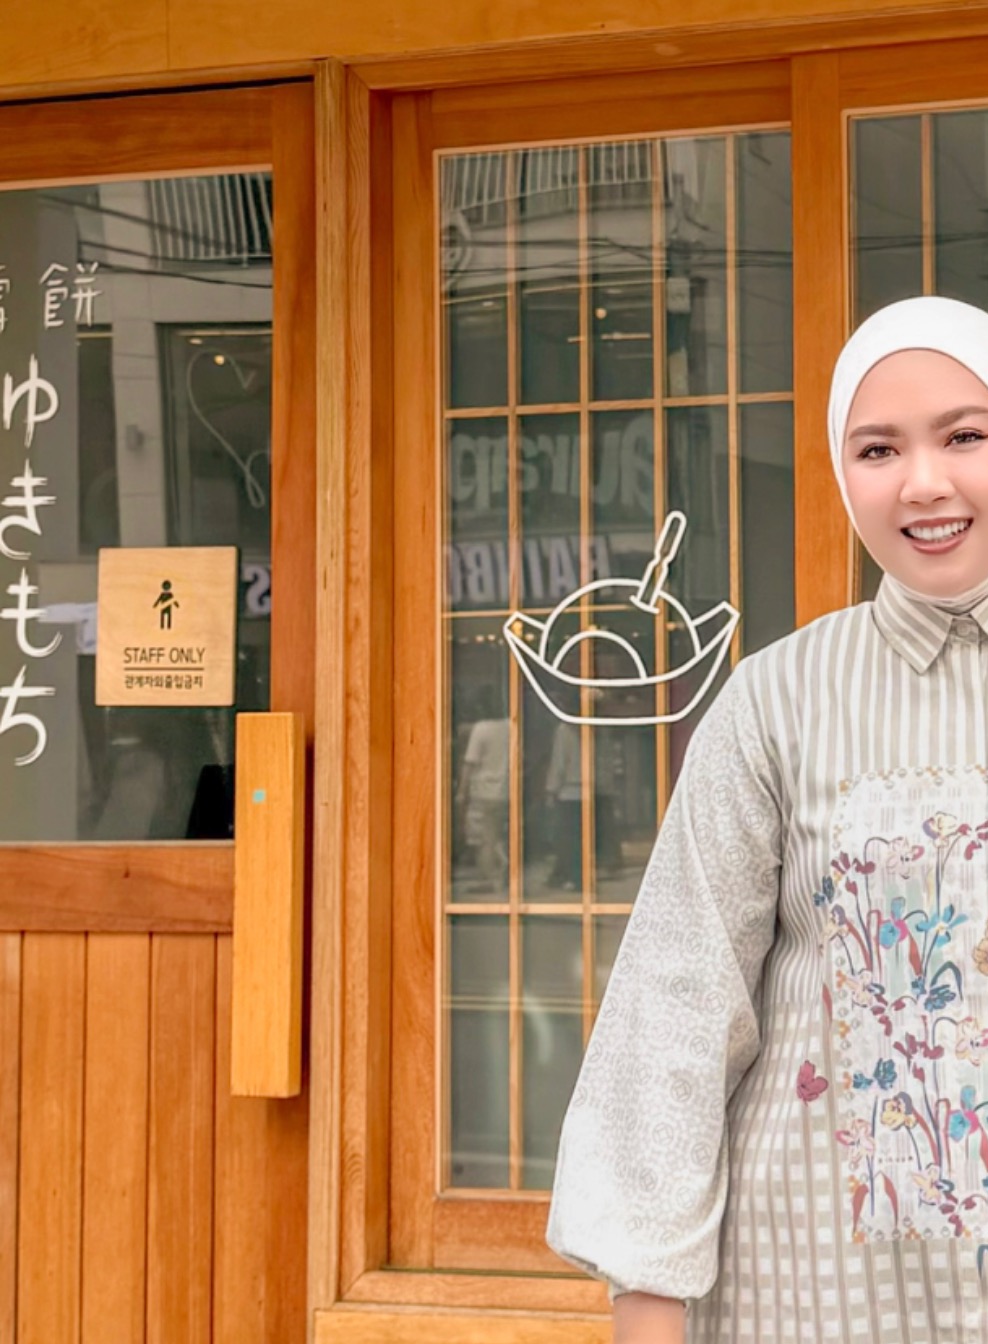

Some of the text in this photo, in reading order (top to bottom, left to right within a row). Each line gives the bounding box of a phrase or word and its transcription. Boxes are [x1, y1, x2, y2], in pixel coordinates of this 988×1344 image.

[0, 353, 62, 767] ゆきもち
[124, 647, 206, 664] STAFF ONLY
